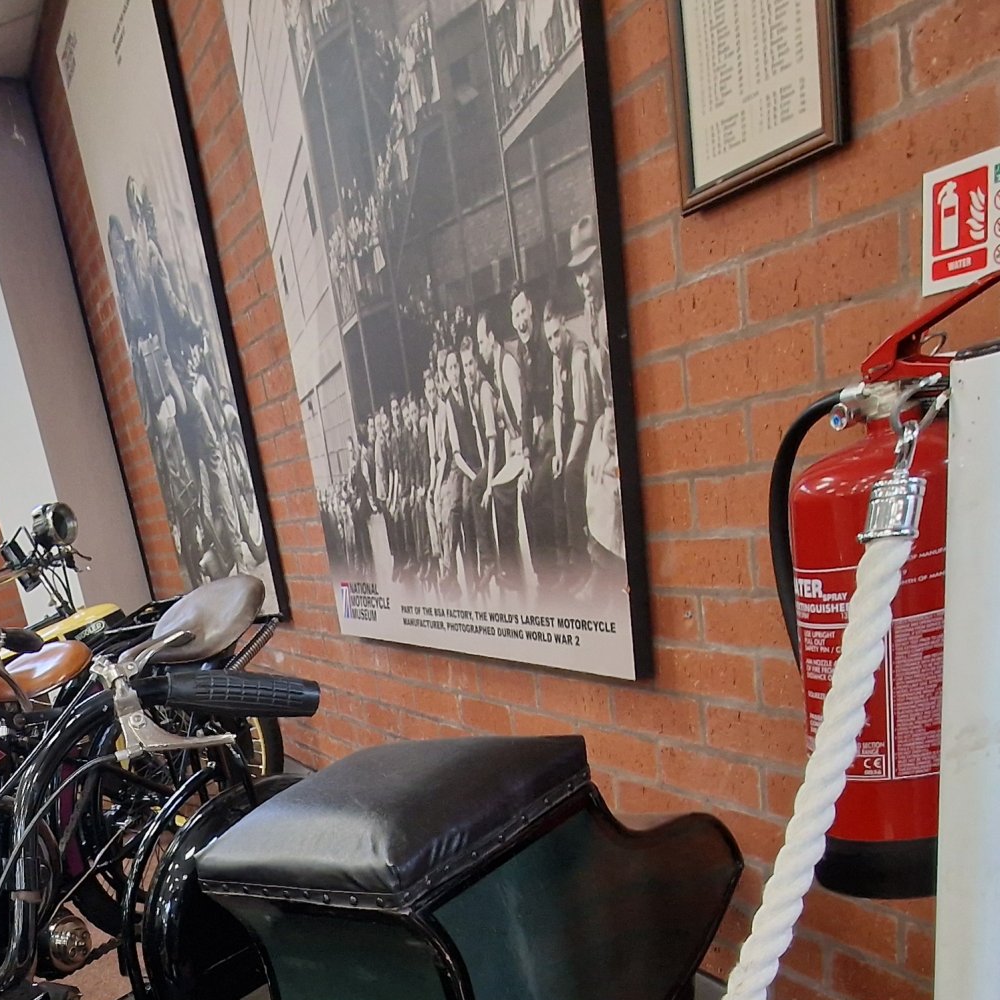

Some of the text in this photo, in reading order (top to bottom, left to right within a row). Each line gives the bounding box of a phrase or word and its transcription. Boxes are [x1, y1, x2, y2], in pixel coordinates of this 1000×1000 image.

[947, 257, 972, 272] WATER
[350, 582, 379, 595] NATIONAL
[794, 579, 848, 602] ATER SPRAY
[350, 595, 390, 610] MOTORCYCLE
[351, 608, 377, 621] MUSEUM
[401, 605, 616, 633] PART OF THE BSA FACTORY, THE WORLD'S LARGEST MOTORCYCLE
[403, 618, 581, 646] MANUFACTURER, PHOTOGRAPHED DURING WORLD WAR 2
